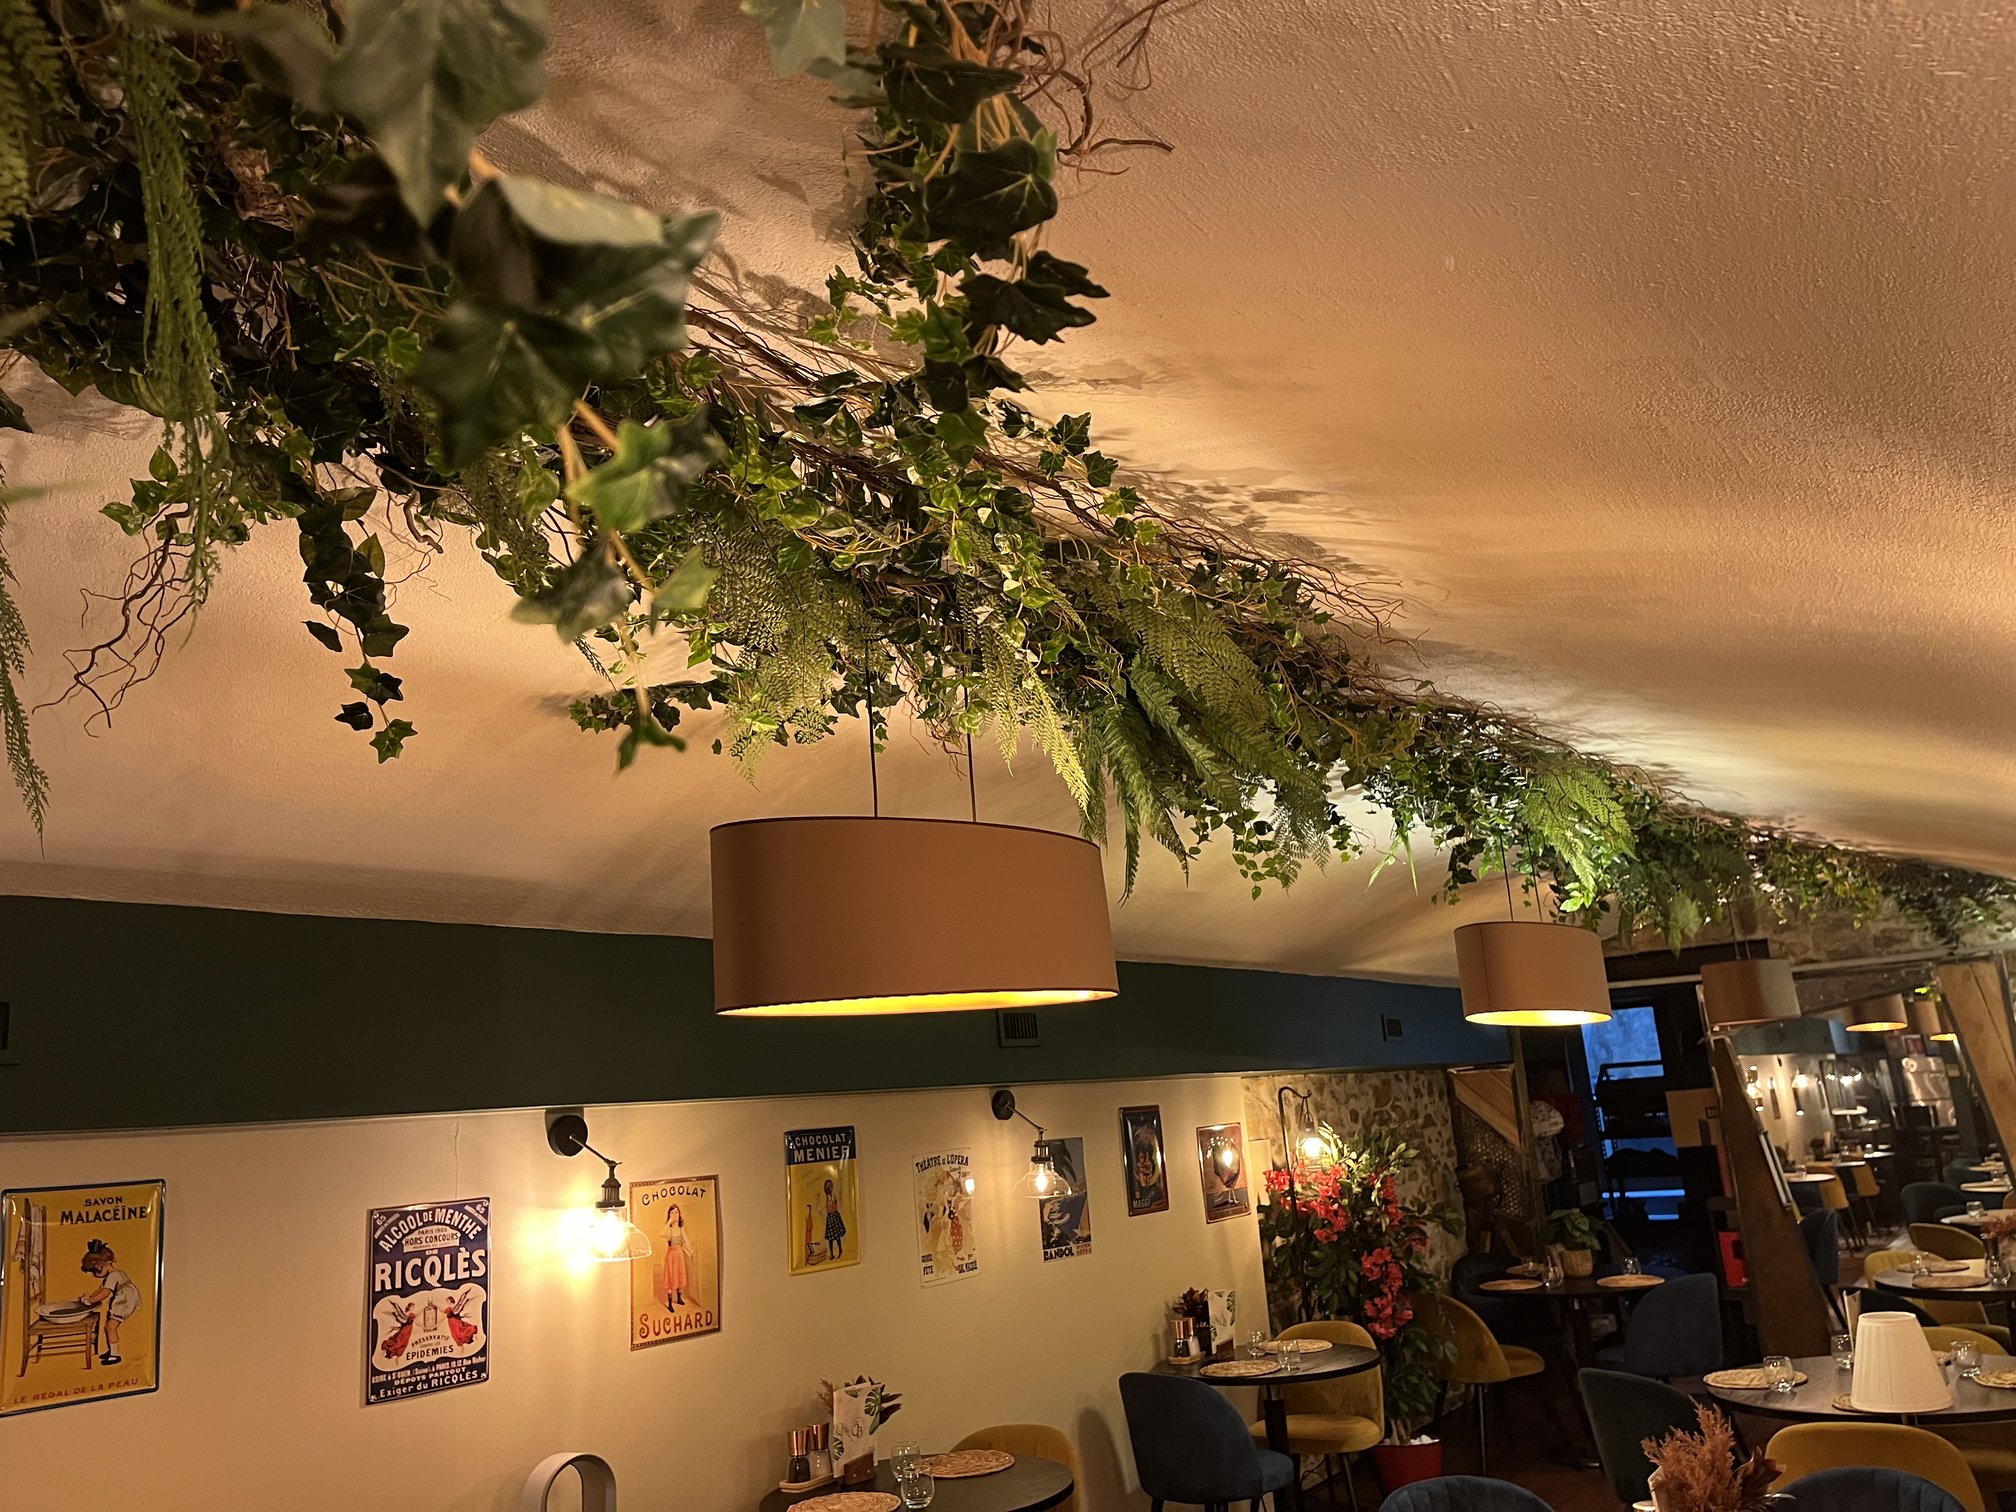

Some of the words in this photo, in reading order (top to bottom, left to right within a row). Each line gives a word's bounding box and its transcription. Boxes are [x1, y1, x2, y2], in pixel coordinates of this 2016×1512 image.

[795, 1133, 846, 1147] CHOCOLAT
[794, 1145, 850, 1163] MENIER
[85, 1196, 123, 1207] SAVON
[641, 1185, 706, 1206] CHOCOLAT
[379, 1212, 424, 1252] ALCOOL
[423, 1211, 433, 1223] DE
[434, 1208, 482, 1240] MENTHE
[405, 1236, 423, 1247] HORS
[425, 1232, 459, 1244] CONCOURS
[375, 1247, 487, 1292] RICQLÈS
[639, 1310, 713, 1339] SUCHARD
[429, 1367, 466, 1379] PARTOUT
[14, 1396, 26, 1404] LE
[73, 1386, 87, 1395] DE
[91, 1384, 104, 1392] LA
[108, 1378, 139, 1389] PEAU
[380, 1384, 414, 1398] Exiger
[416, 1381, 428, 1390] du
